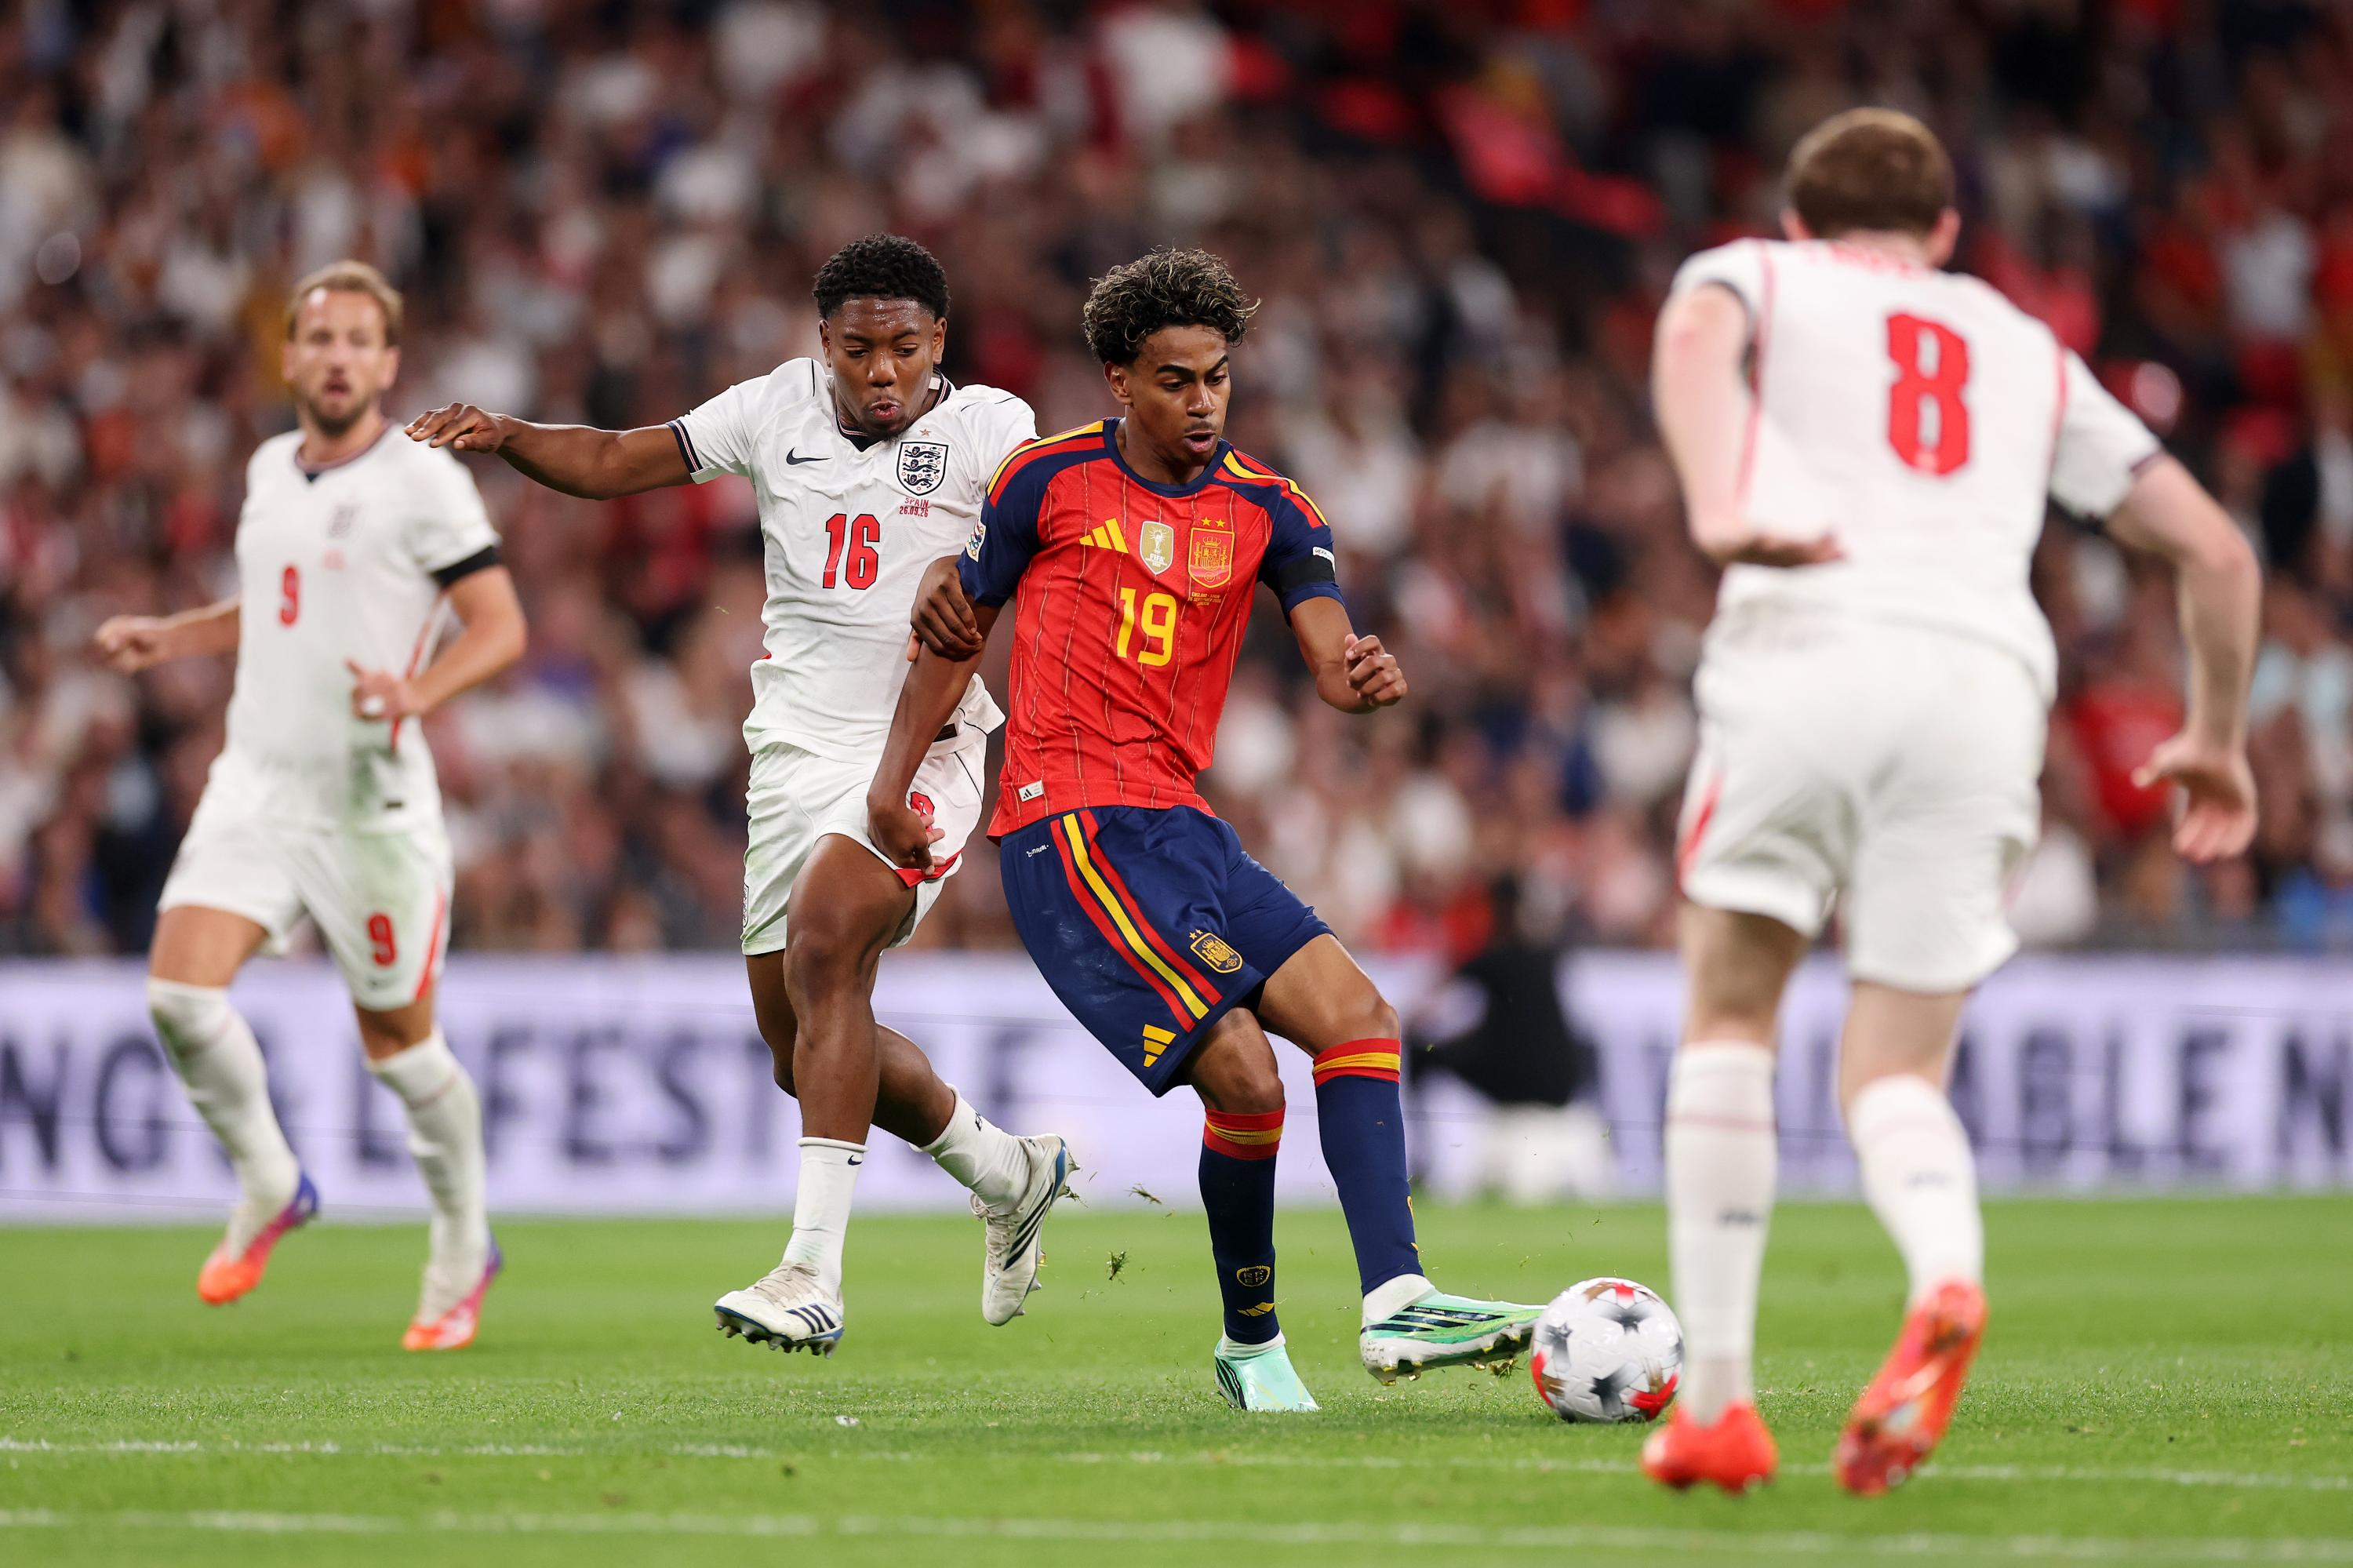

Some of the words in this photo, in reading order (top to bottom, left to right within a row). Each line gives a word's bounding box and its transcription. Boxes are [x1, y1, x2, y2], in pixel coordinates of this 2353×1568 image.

[1885, 311, 1971, 478] 8
[899, 505, 929, 518] 26.09.26
[904, 497, 929, 508] SPAIN
[823, 513, 880, 590] 16
[279, 565, 300, 628] 9
[1117, 587, 1177, 667] 19
[367, 913, 397, 967] 9
